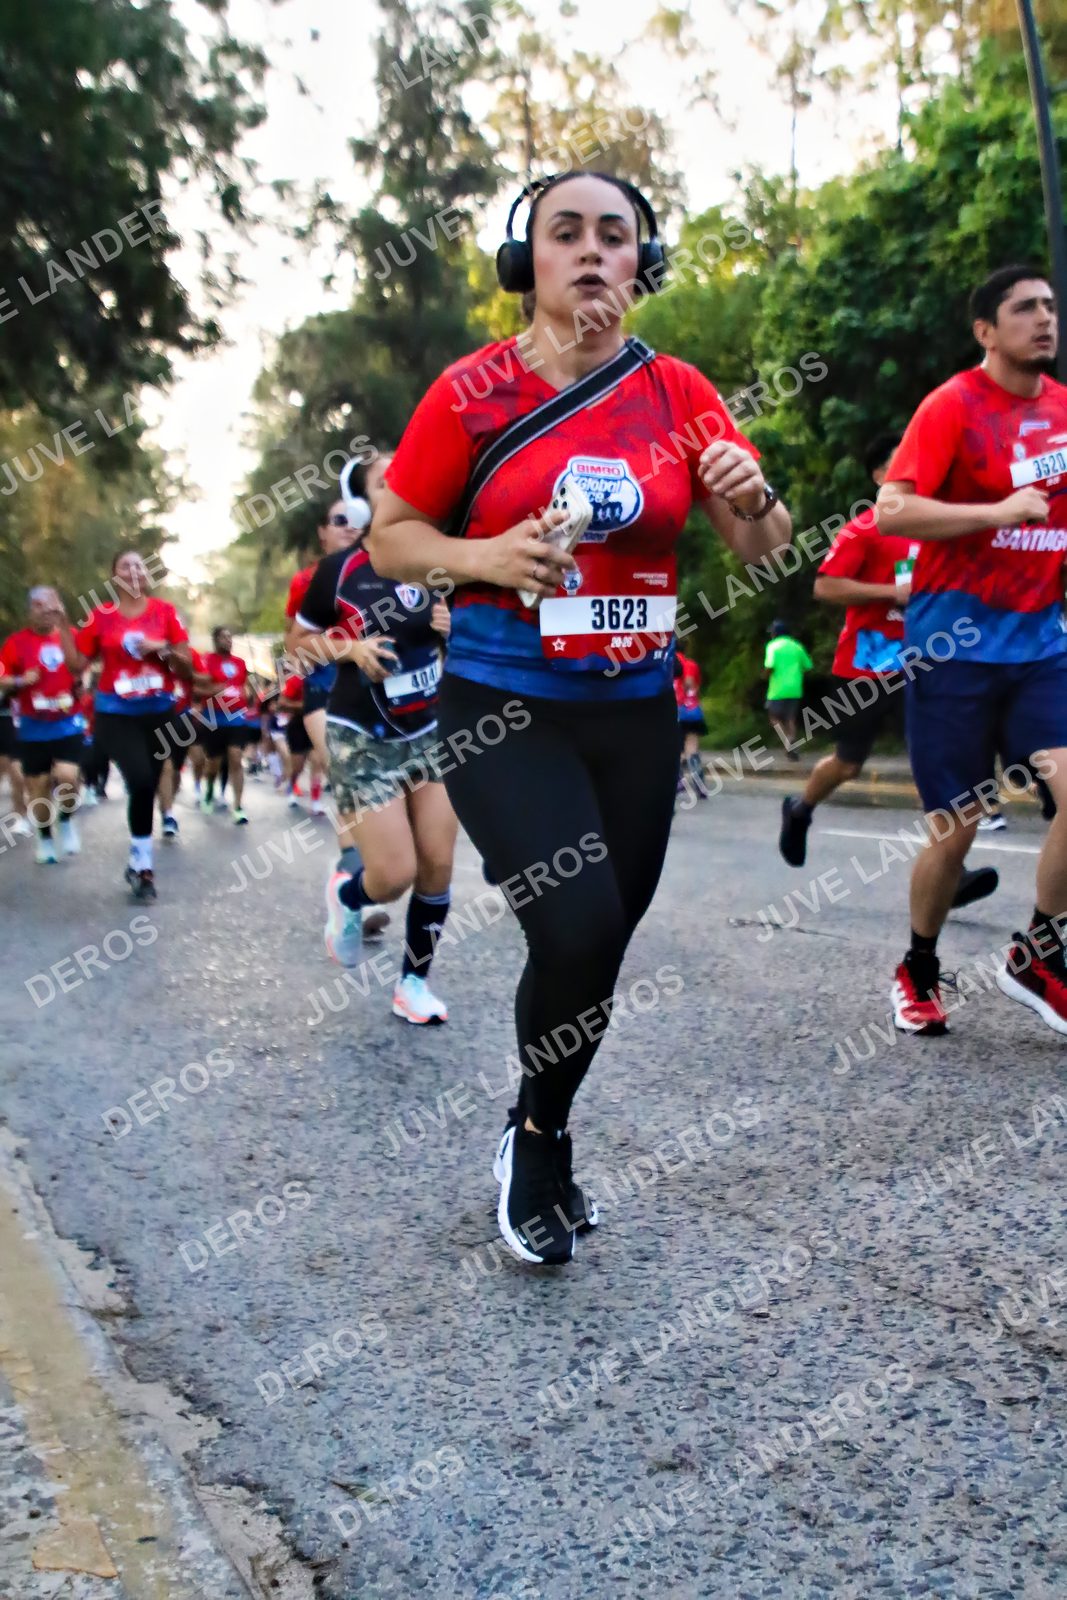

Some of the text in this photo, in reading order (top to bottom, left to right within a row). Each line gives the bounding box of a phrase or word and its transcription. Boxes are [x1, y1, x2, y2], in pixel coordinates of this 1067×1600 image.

[576, 464, 620, 475] BIMBO
[1033, 452, 1066, 479] 3520
[577, 477, 621, 493] Global
[991, 528, 1067, 552] SANTIAG
[591, 598, 647, 630] 3623
